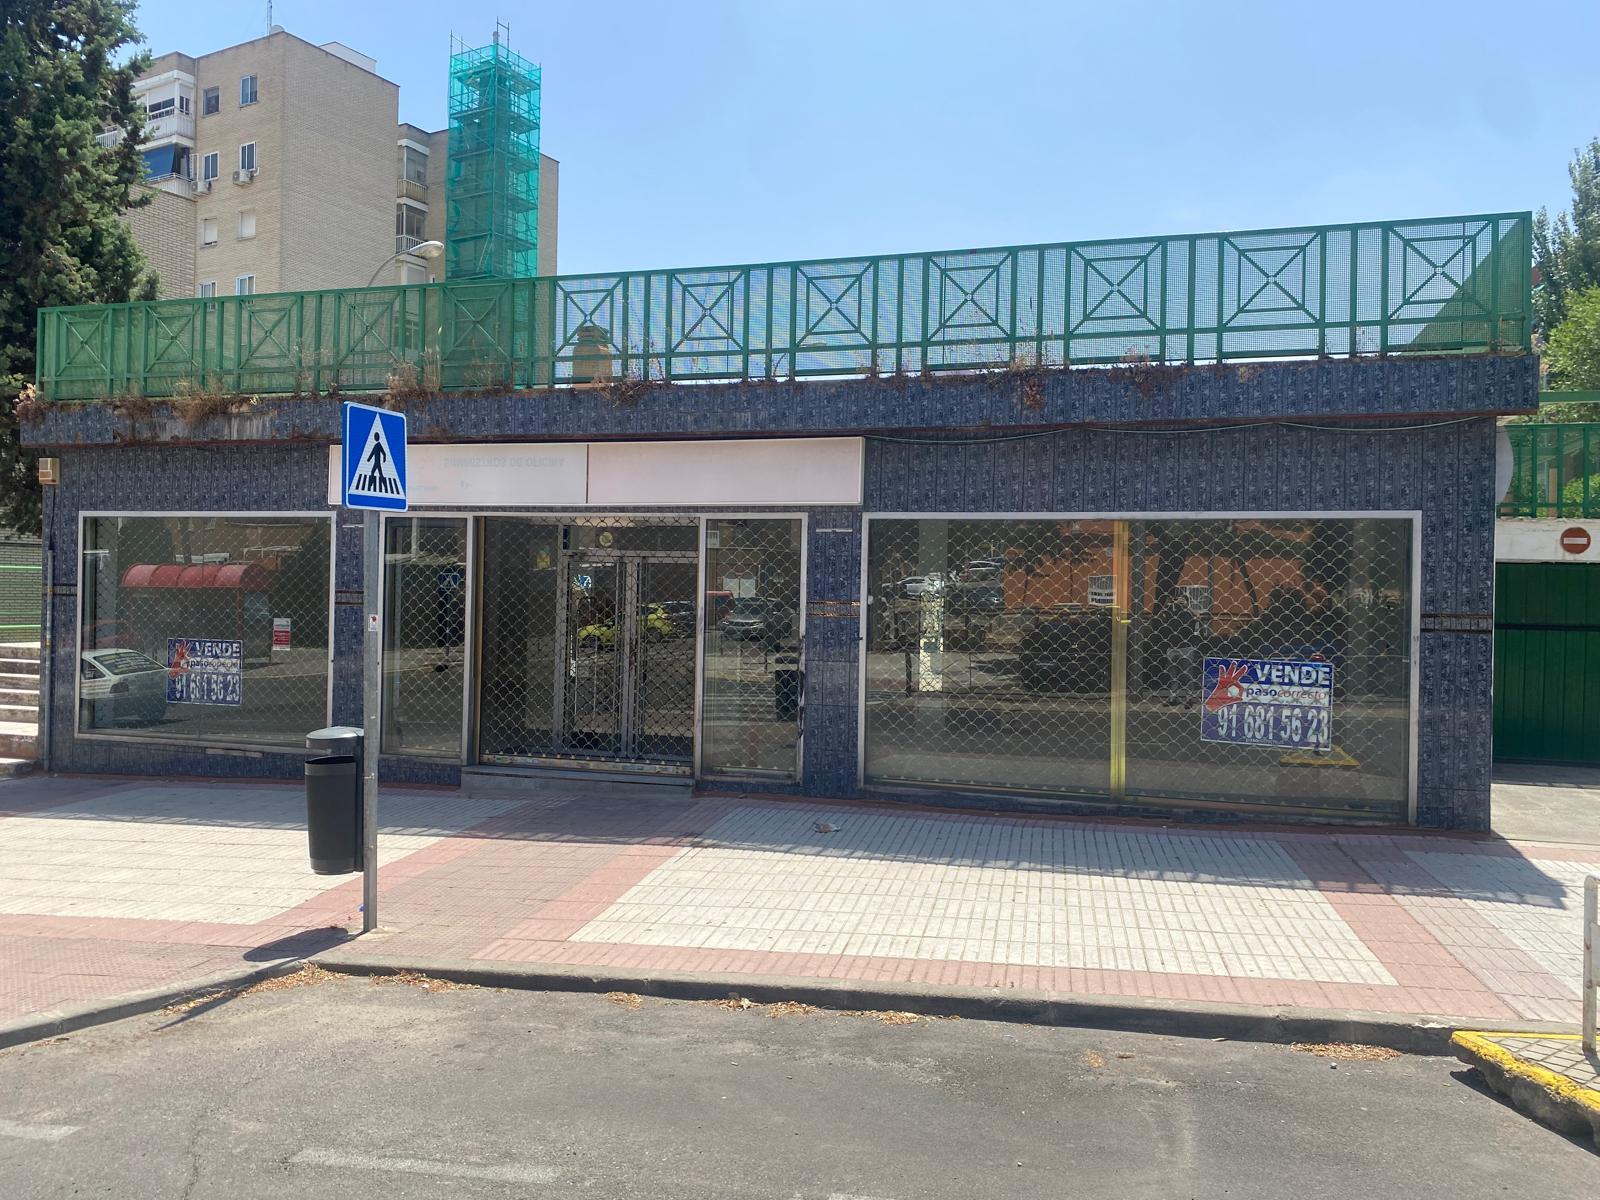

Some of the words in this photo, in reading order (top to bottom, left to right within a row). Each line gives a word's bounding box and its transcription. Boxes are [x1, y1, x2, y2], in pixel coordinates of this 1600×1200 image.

[195, 642, 240, 657] VENDE
[1254, 664, 1330, 685] VENDE
[175, 674, 186, 698] 91
[1246, 687, 1326, 699] pasocorrecto
[1217, 704, 1237, 736] 91
[1244, 705, 1273, 739] 681
[1280, 707, 1302, 742] 56
[1307, 708, 1328, 743] 23
